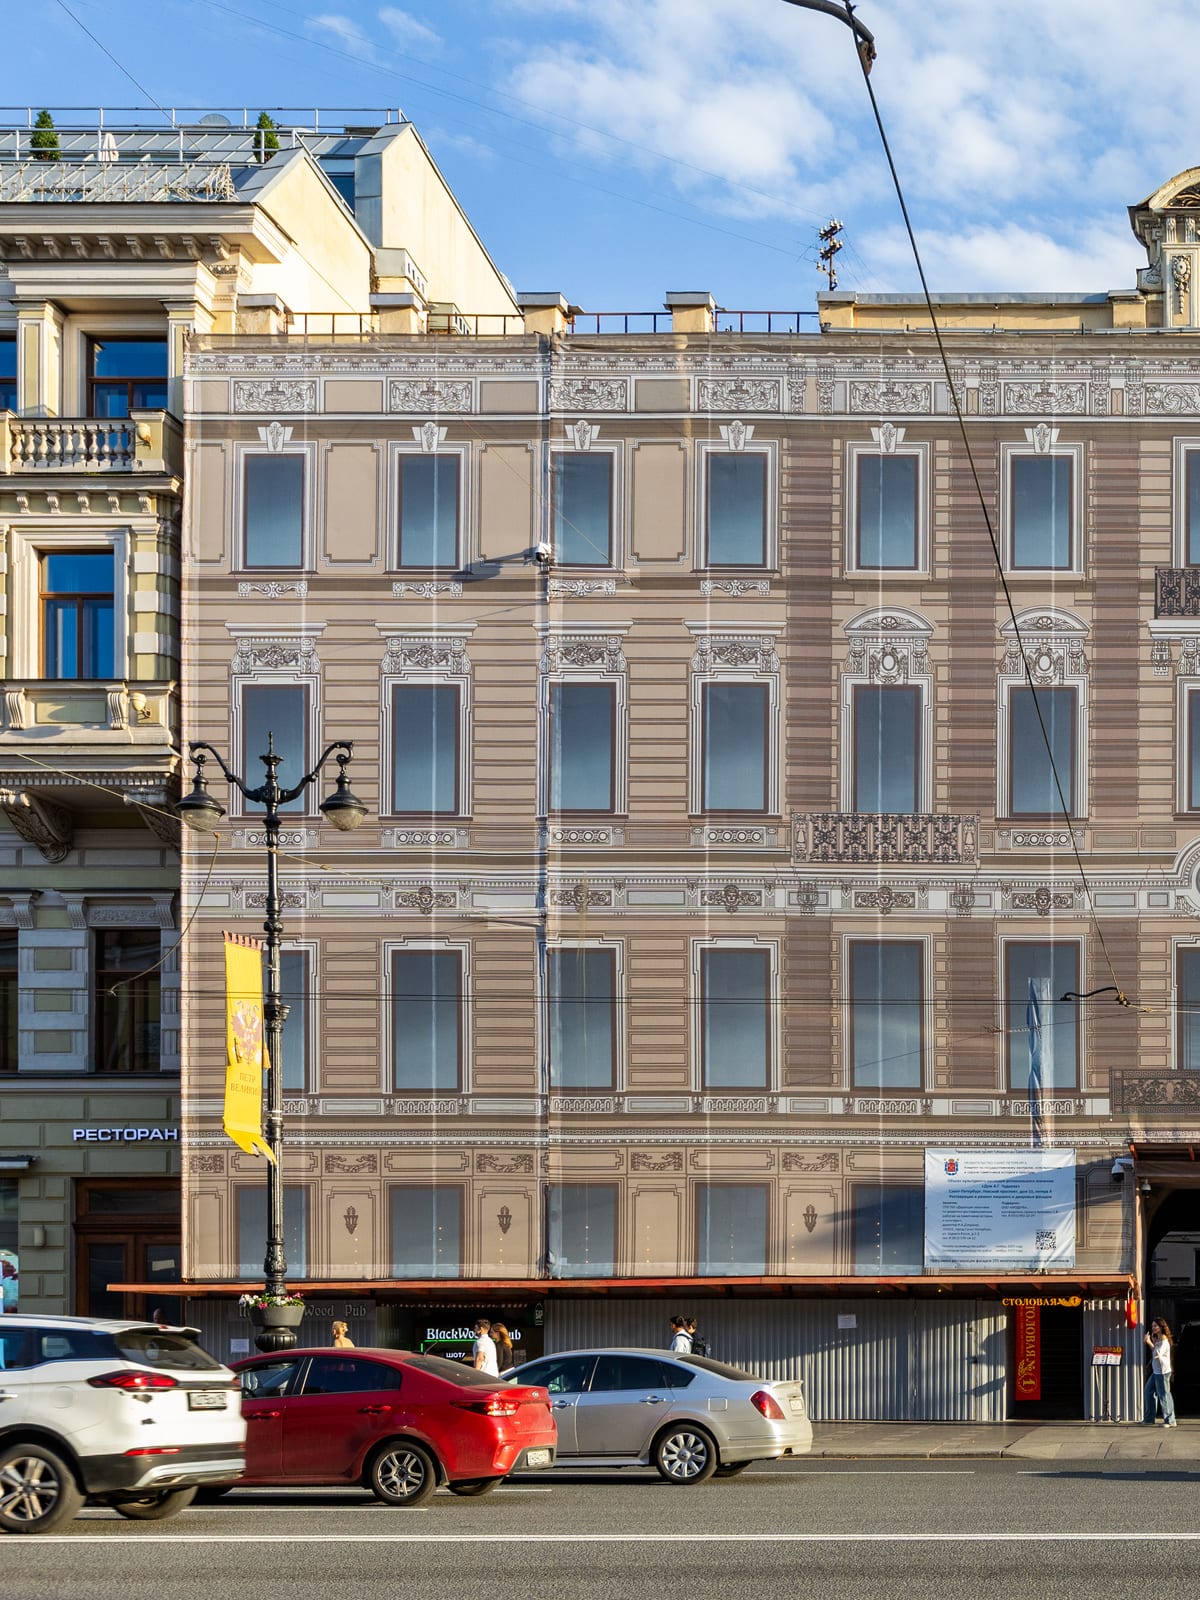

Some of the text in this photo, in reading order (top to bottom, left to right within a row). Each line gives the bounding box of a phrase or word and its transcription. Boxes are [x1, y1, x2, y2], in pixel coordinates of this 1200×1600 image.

[72, 1128, 178, 1141] РЕСТОРАН
[1002, 1297, 1057, 1306] СТОЛОВАЯ
[344, 1303, 367, 1318] Pub
[426, 1327, 479, 1340] BlackWo
[1025, 1305, 1036, 1357] ТОЛОВАЯ
